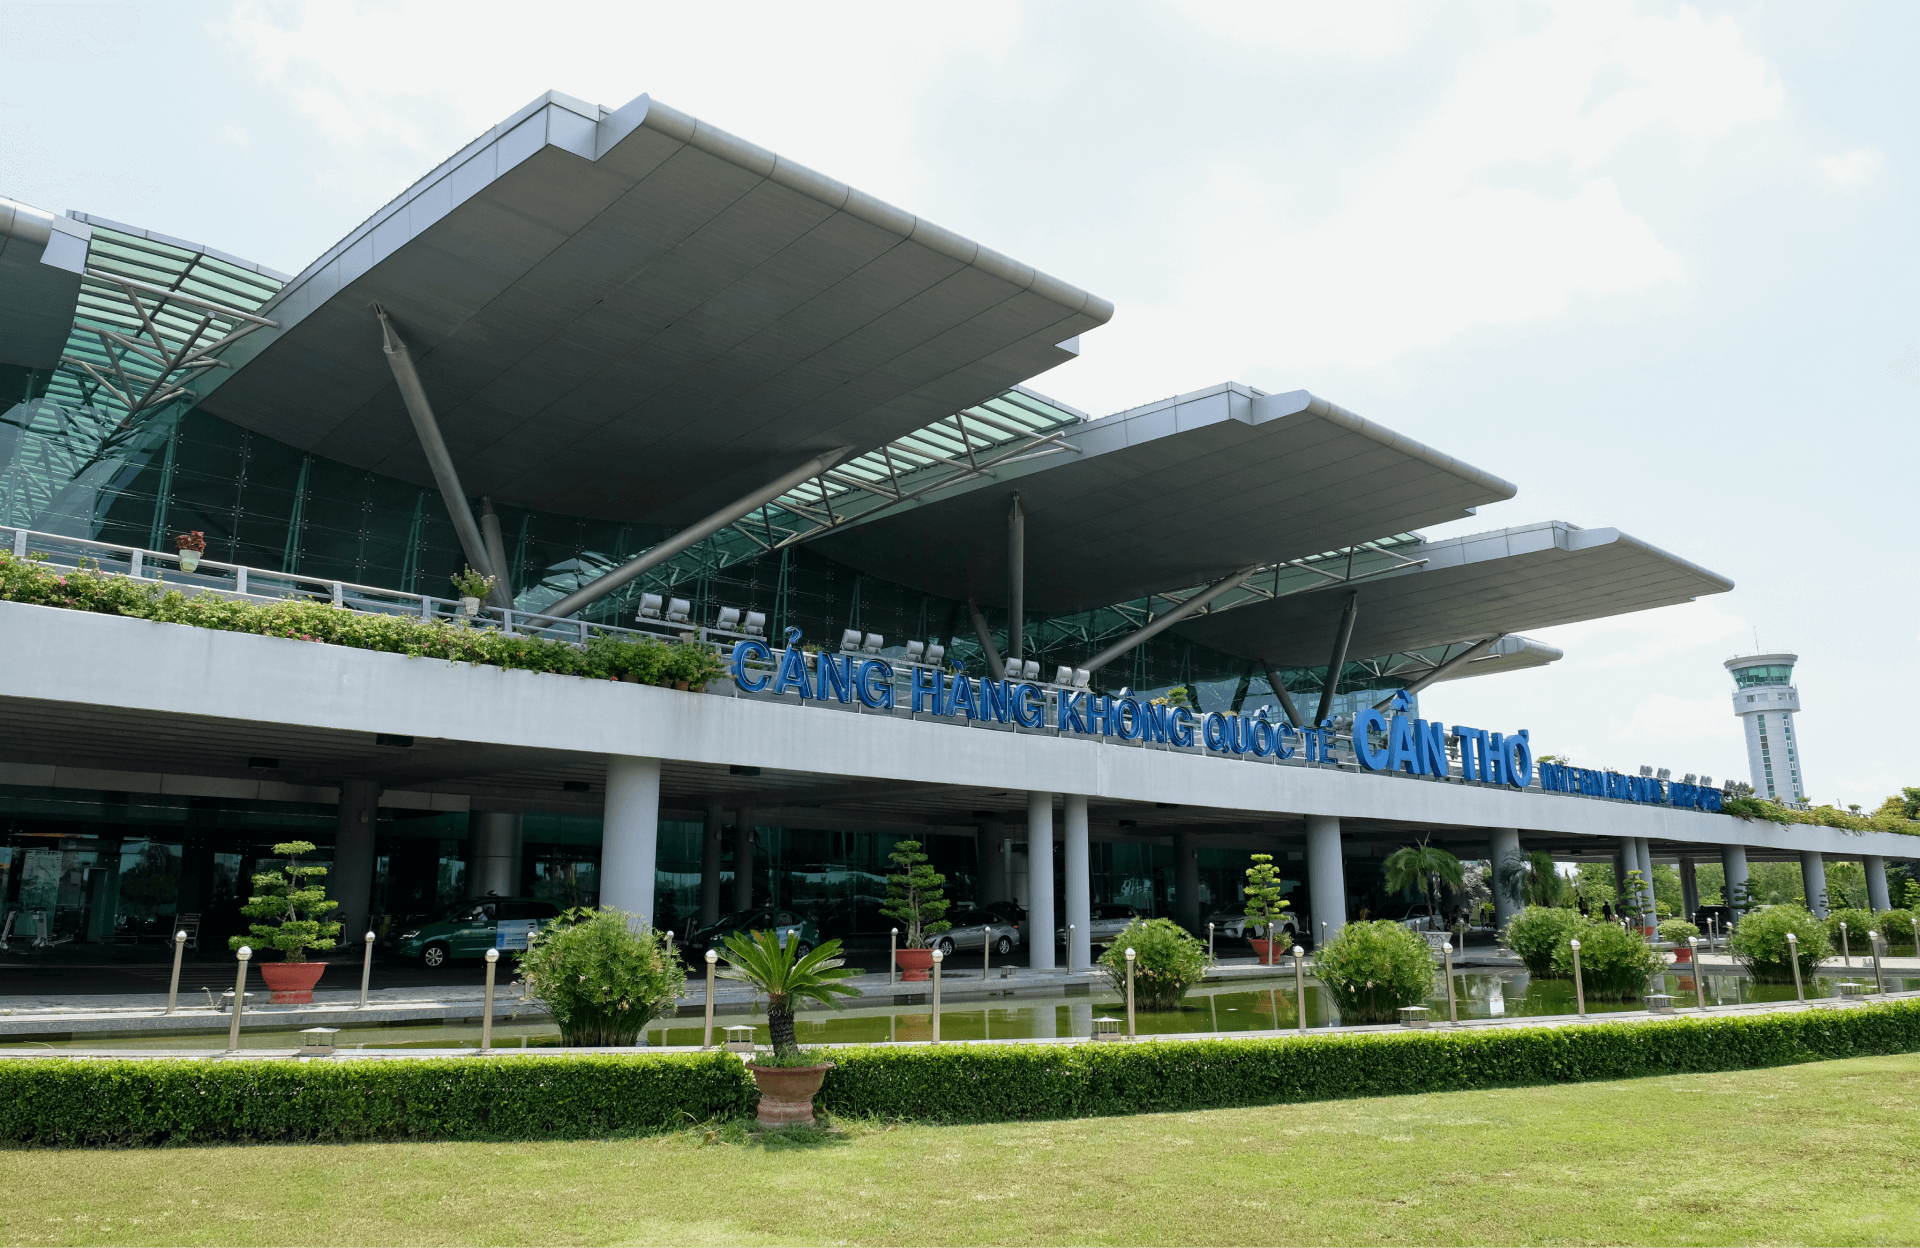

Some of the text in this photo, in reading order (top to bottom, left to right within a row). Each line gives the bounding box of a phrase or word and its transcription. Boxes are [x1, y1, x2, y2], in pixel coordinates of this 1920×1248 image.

[731, 625, 1338, 764] CẢNG HÀNG KHÔNG QUỐC TẾ
[1352, 689, 1532, 788] CẦN THƠ
